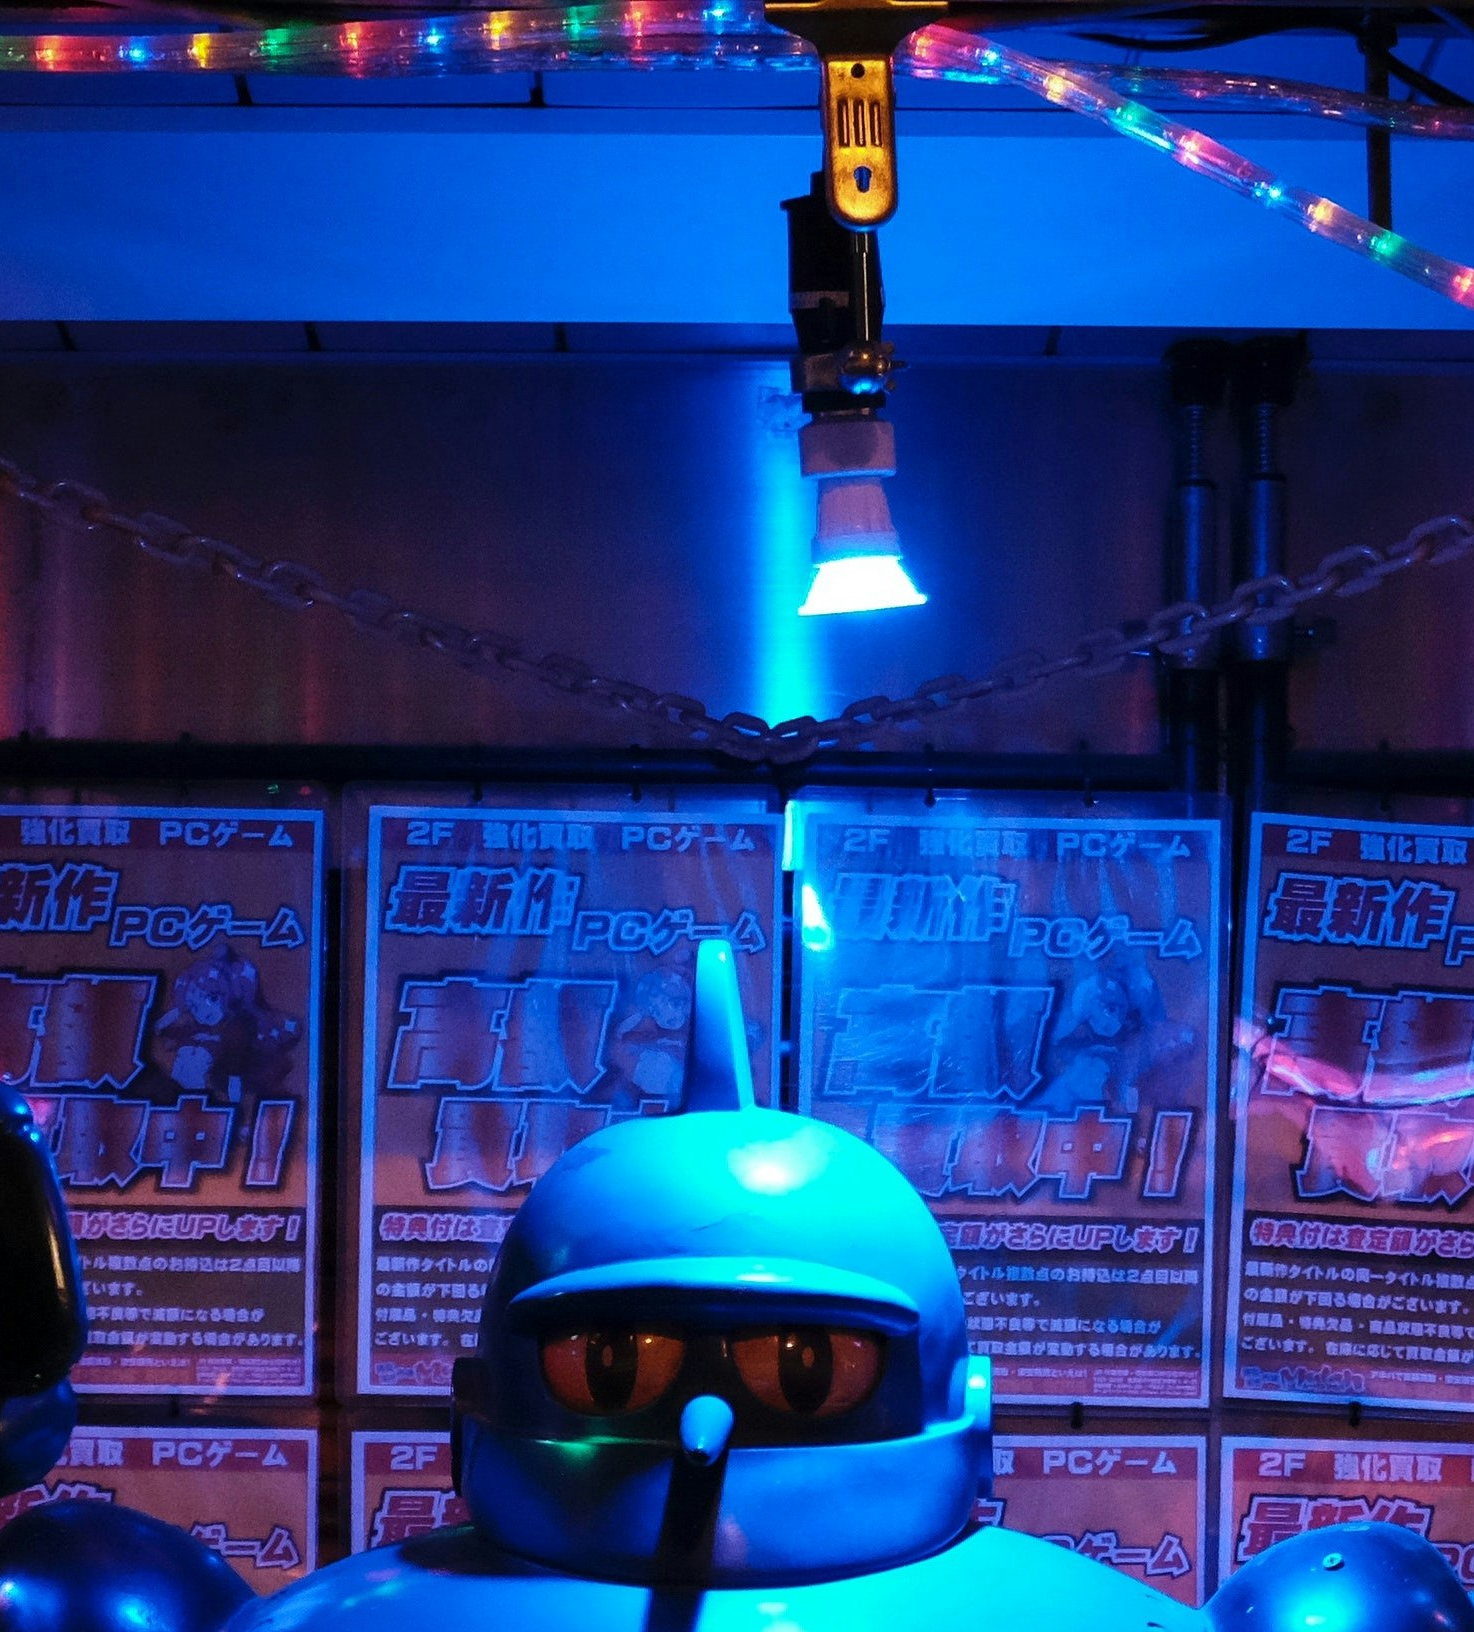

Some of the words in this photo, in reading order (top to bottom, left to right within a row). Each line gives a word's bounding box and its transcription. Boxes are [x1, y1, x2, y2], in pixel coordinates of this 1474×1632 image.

[20, 816, 132, 847] 強化買取
[158, 819, 295, 848] PCゲーム
[406, 821, 453, 849] 2F
[481, 821, 591, 853] 強化買取
[618, 825, 753, 856] PCゲーム
[841, 823, 889, 851] 2F
[1056, 828, 1194, 859] PCゲーム
[1287, 827, 1335, 857] 2F
[1362, 831, 1473, 866] 強化買取
[110, 902, 307, 949] PCゲーム
[385, 864, 580, 939] 最新作
[570, 908, 765, 958] PCゲーム
[1264, 870, 1460, 950] 最新作
[1008, 911, 1205, 961] PCゲーム
[152, 1439, 289, 1467] PCゲーム
[390, 1445, 438, 1471] 2F
[1043, 1451, 1178, 1476] PCゲーム
[1258, 1452, 1306, 1478] 2F
[1334, 1453, 1442, 1483] 強化買取
